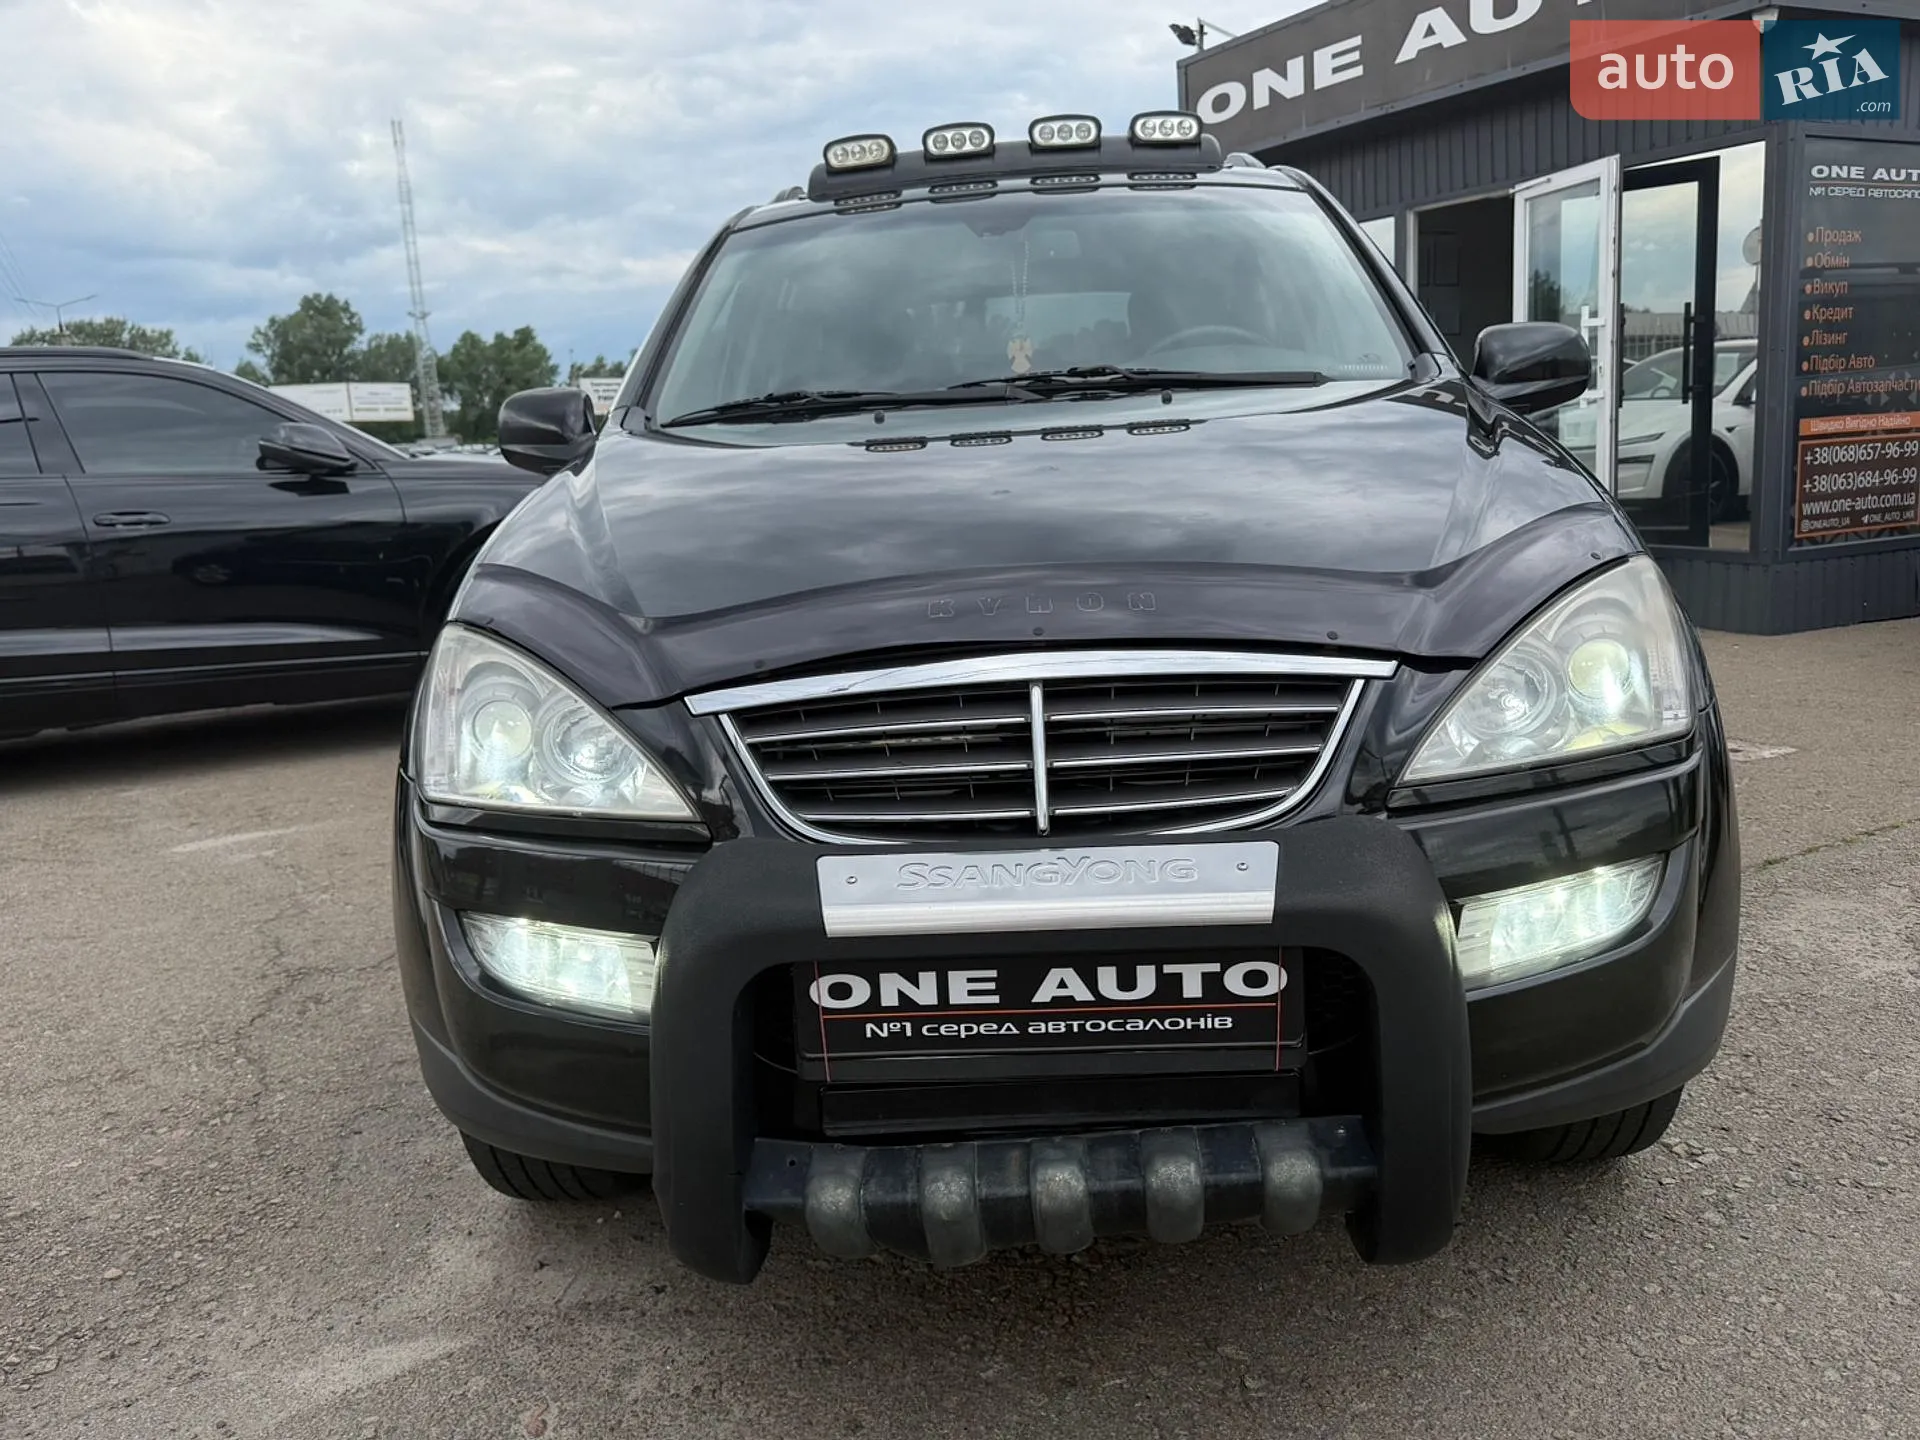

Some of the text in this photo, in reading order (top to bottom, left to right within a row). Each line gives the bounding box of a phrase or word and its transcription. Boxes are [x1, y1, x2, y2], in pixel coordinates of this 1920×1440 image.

[1196, 0, 1593, 125] ONE AU
[1810, 165, 1865, 179] ONE
[1815, 226, 1862, 246] Продаж
[1814, 251, 1850, 268] Обмін
[1813, 278, 1848, 298] Викуп
[1812, 303, 1854, 323] Кредит
[1810, 328, 1848, 345] Лізинг
[1810, 353, 1876, 373] Підбір Авто
[1808, 379, 1845, 397] Підбір
[1804, 440, 1919, 466] +38(068)657-96-99
[1803, 467, 1918, 493] +38(063)684-96-99
[1802, 491, 1916, 516] www.one-auto.com.ua
[896, 856, 1199, 889] SSANGYONG
[809, 961, 1289, 1010] ONE AUTO
[921, 1020, 1020, 1039] серед
[1027, 1013, 1234, 1034] автосалонів
